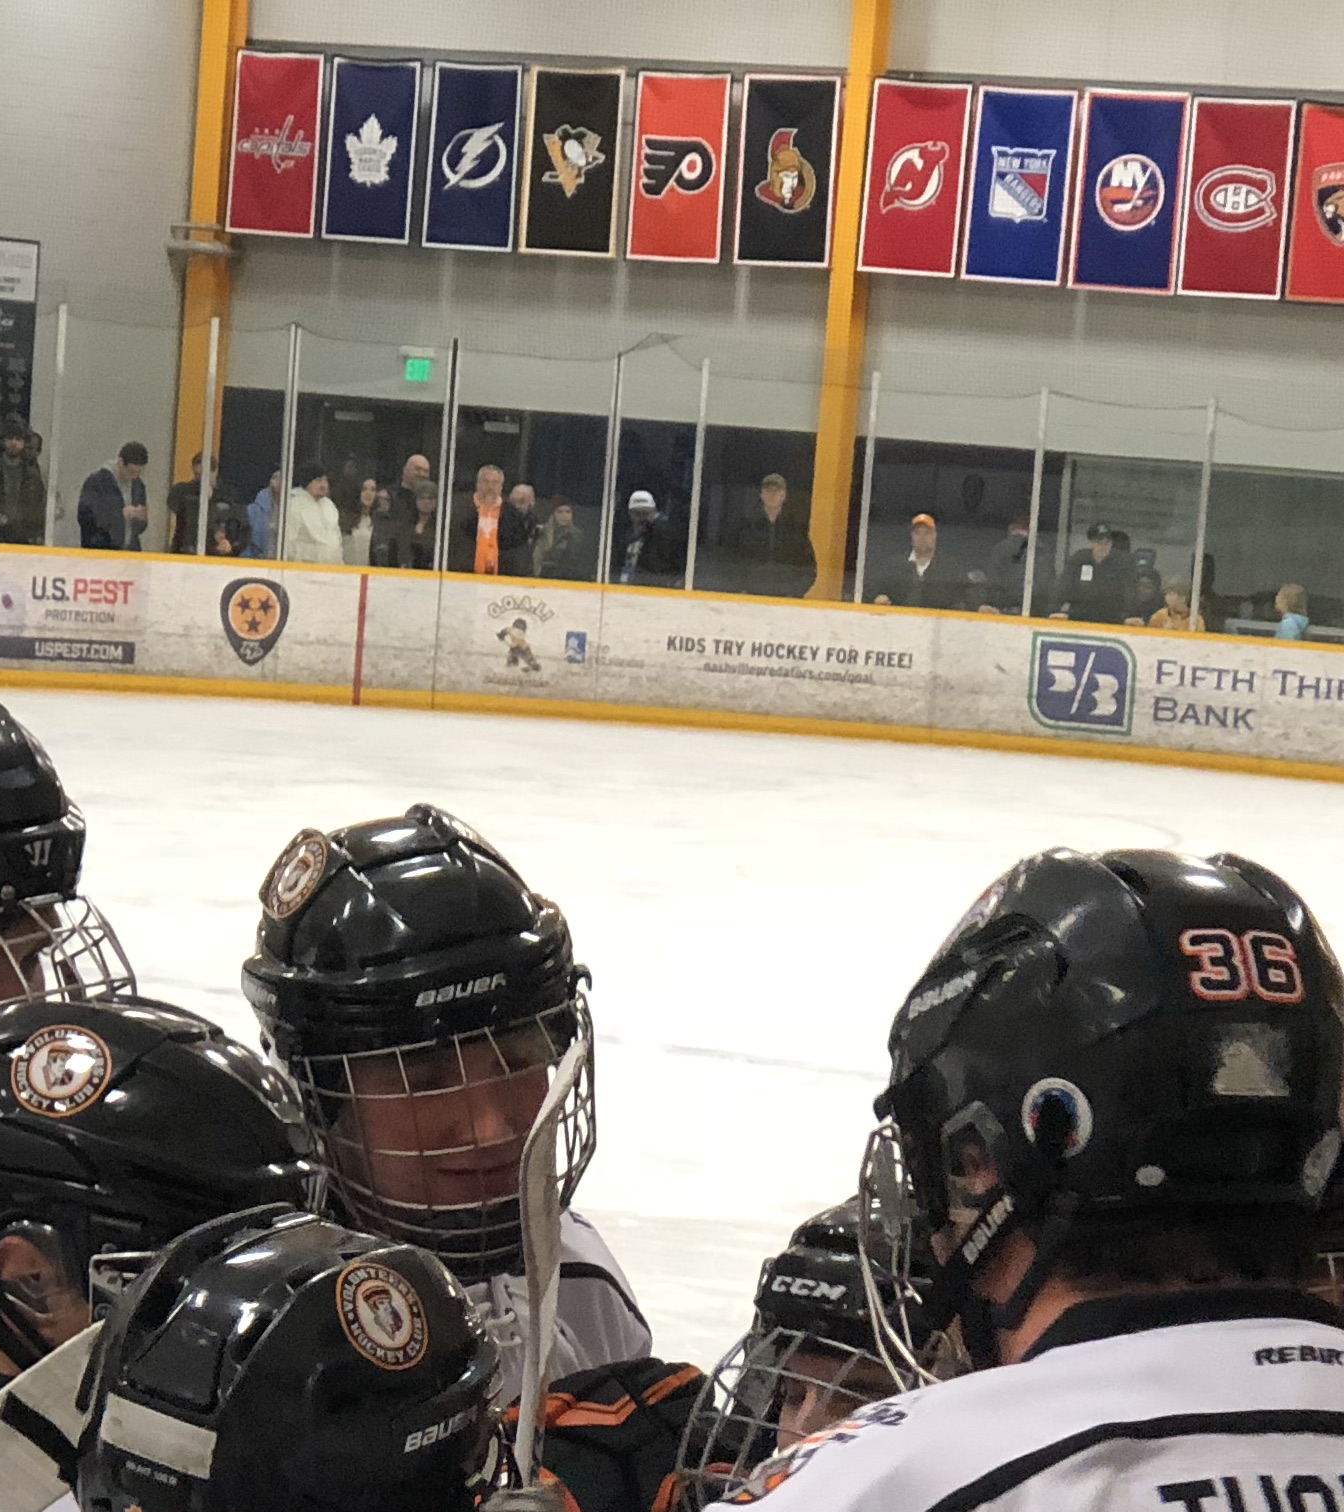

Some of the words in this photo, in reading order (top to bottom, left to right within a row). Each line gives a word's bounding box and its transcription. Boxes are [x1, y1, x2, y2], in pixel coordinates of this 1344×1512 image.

[32, 576, 70, 602] U.S.
[72, 577, 135, 605] PEST
[45, 608, 115, 624] PROTECTION
[35, 642, 123, 660] USPEST.COM
[666, 635, 707, 654] KIDS
[713, 638, 746, 657] TRY
[751, 641, 820, 662] HOCKEY
[826, 647, 859, 665] FOR
[864, 650, 914, 669] FREE!
[1178, 928, 1305, 1004] 36
[771, 1275, 848, 1300] CCM
